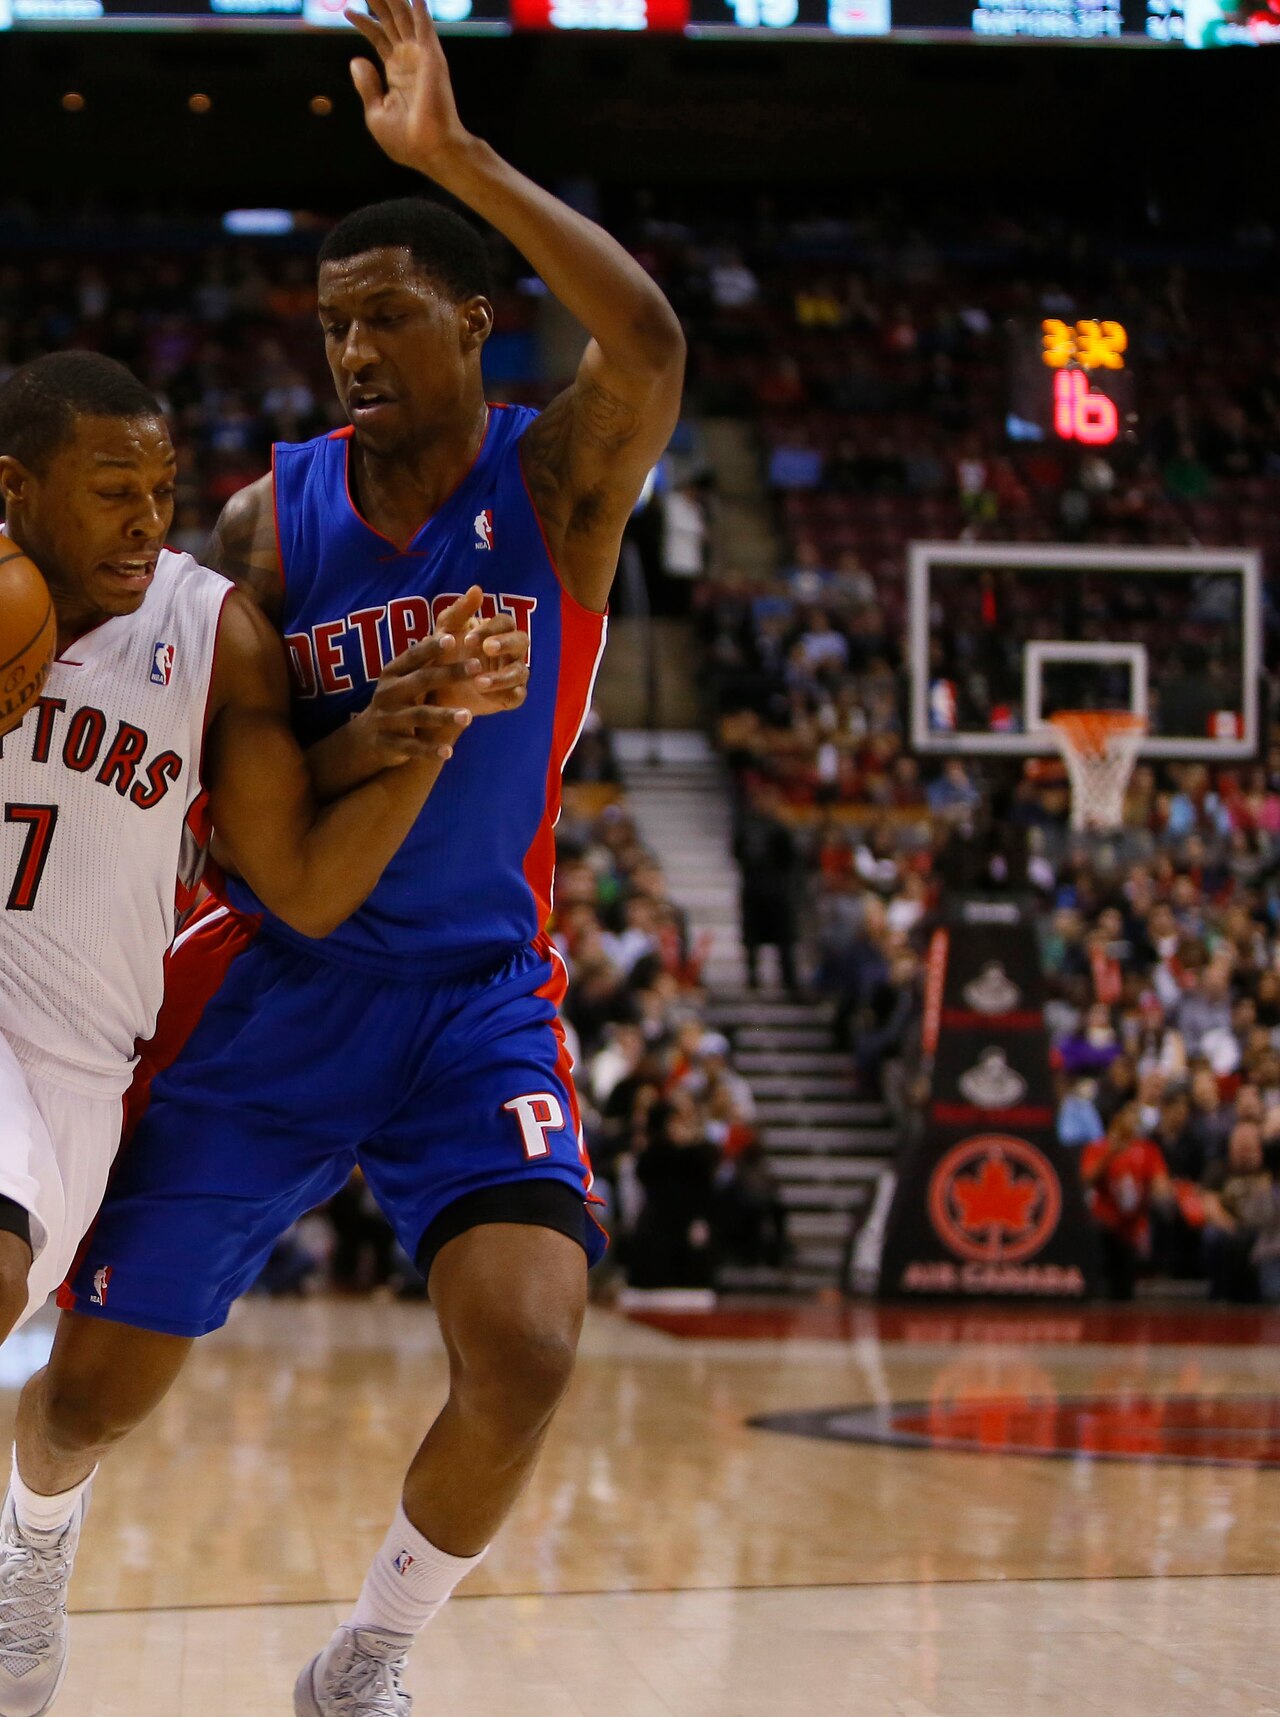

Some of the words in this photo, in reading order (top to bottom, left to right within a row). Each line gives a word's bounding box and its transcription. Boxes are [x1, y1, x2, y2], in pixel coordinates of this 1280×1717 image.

[1054, 369, 1118, 445] 16
[283, 593, 538, 700] DETRT
[4, 802, 59, 911] 7
[502, 1092, 566, 1161] P
[960, 1262, 1086, 1294] CANADA
